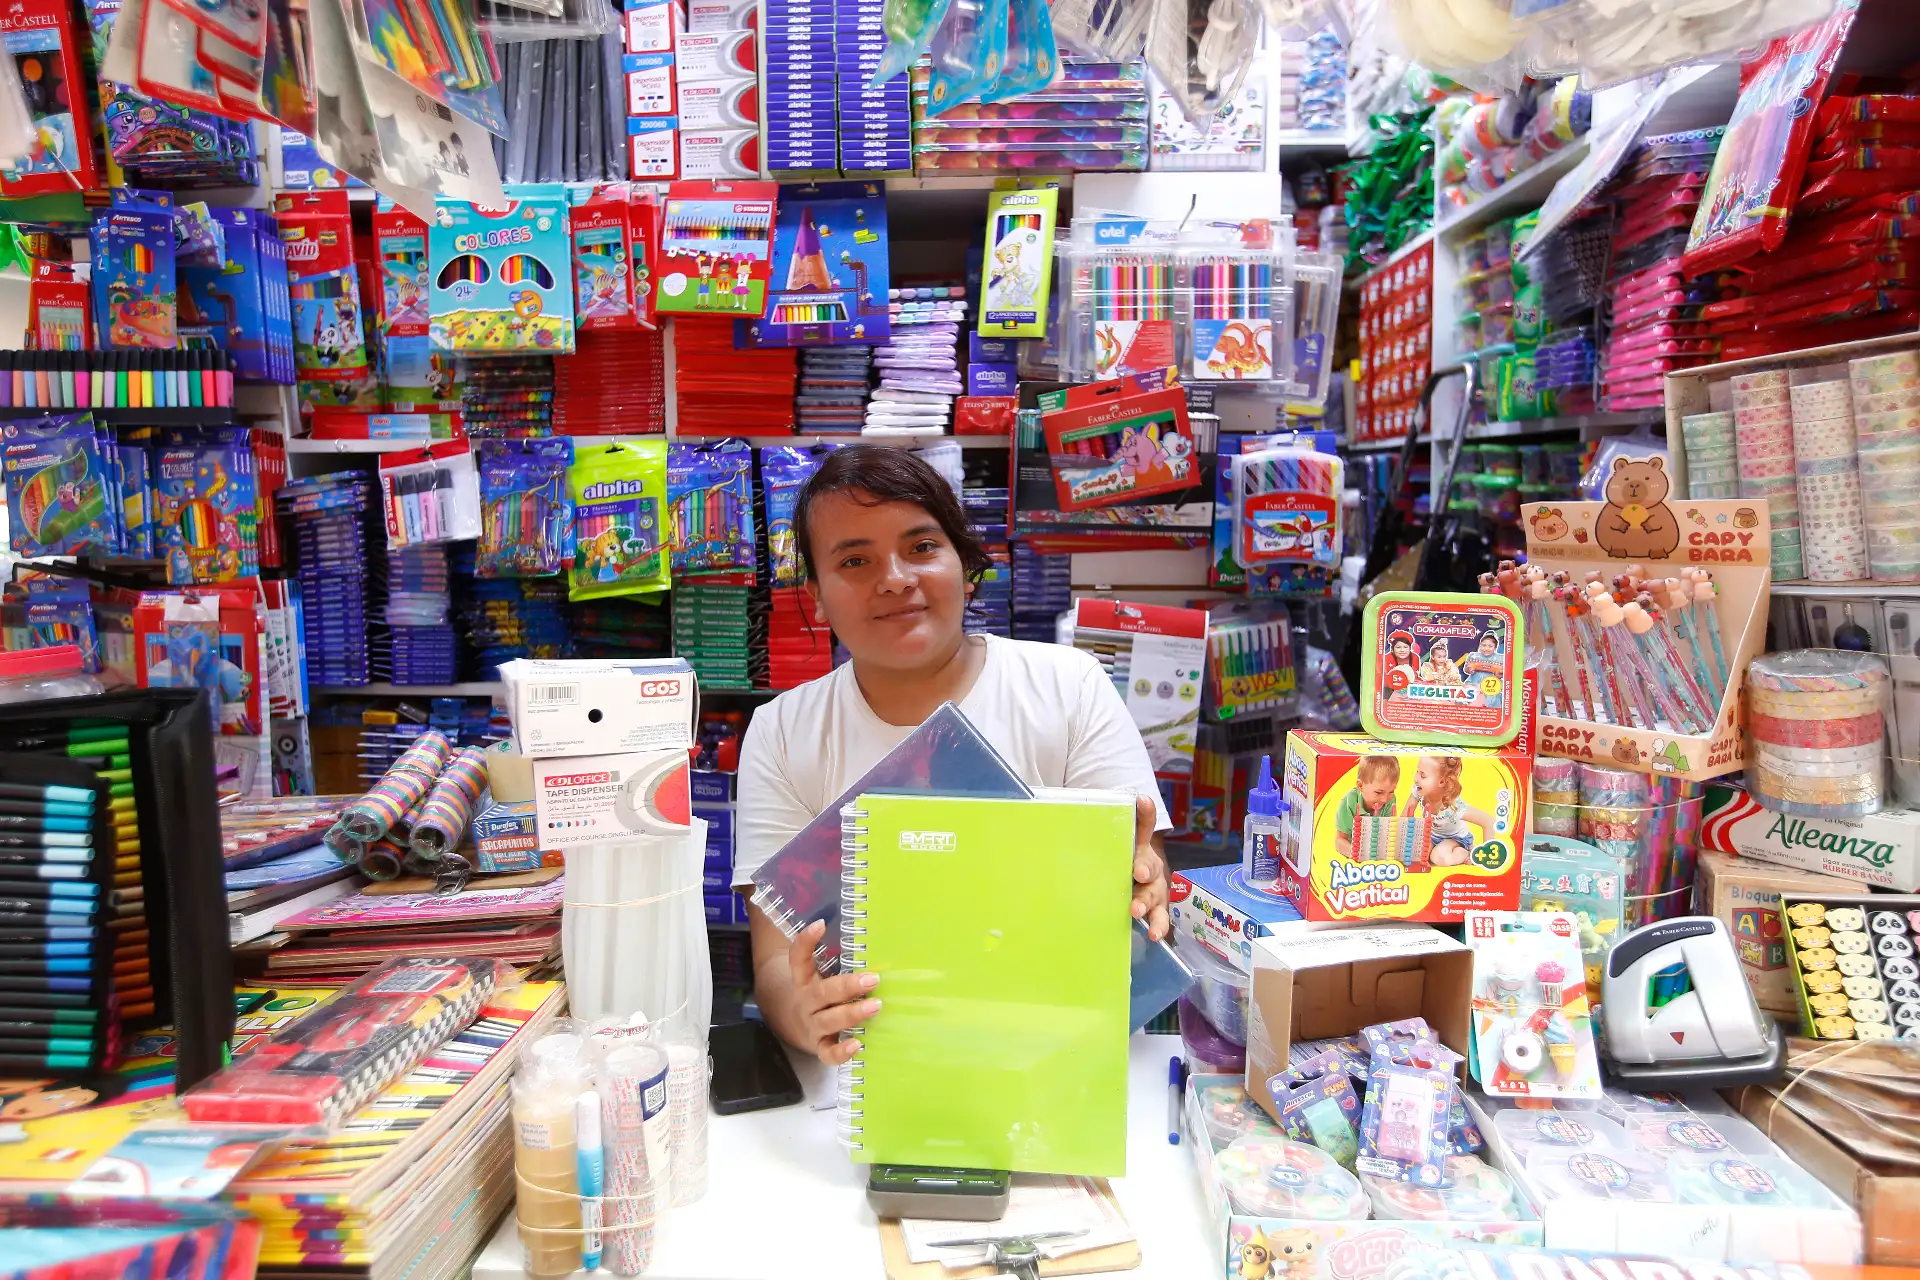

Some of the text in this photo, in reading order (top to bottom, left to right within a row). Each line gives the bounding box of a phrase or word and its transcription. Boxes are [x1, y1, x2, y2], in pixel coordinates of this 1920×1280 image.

[97, 1, 124, 9] ARTE
[1002, 194, 1039, 205] alpha
[112, 214, 142, 223] ARTESCO
[573, 217, 622, 228] FABER-CASTELL
[378, 227, 425, 235] FABER-CASTELL
[455, 226, 533, 252] COLORES
[39, 265, 51, 276] 10
[455, 286, 471, 296] 24
[38, 298, 84, 307] FABER-CASTELL
[976, 370, 1006, 381] alpha
[1088, 407, 1142, 424] FABER-CASTELL
[7, 444, 37, 452] ARTESCO
[161, 464, 172, 479] 12
[584, 480, 643, 500] alpha
[579, 507, 589, 517] 12
[1265, 501, 1317, 510] FABER-CASTELL
[1688, 531, 1754, 546] CAPY
[1688, 548, 1753, 562] BARA
[1416, 625, 1473, 636] DORADAFLEX
[642, 681, 680, 696] GOS
[1485, 679, 1497, 688] 27
[1409, 686, 1475, 700] REGLETAS
[1515, 678, 1532, 755] Maskingtap
[1542, 724, 1595, 744] CAPY
[1541, 739, 1593, 758] BARA
[1706, 751, 1732, 768] BARA
[546, 784, 624, 798] TAPE DISPENSER
[482, 837, 534, 850] SACAPUNTAS
[901, 832, 954, 845] SMART
[1765, 813, 1894, 868] Alleanza
[1822, 857, 1840, 867] Ligas
[1822, 863, 1893, 884] RUBBER BANDS
[1326, 884, 1409, 914] Vertical
[1732, 885, 1780, 904] Bloque
[1247, 923, 1255, 933] 12
[1662, 926, 1706, 935] FABER-CASTELL
[1737, 914, 1756, 936] A
[1772, 946, 1784, 963] B
[1323, 1080, 1348, 1096] FUN!
[1332, 1238, 1402, 1277] eras
